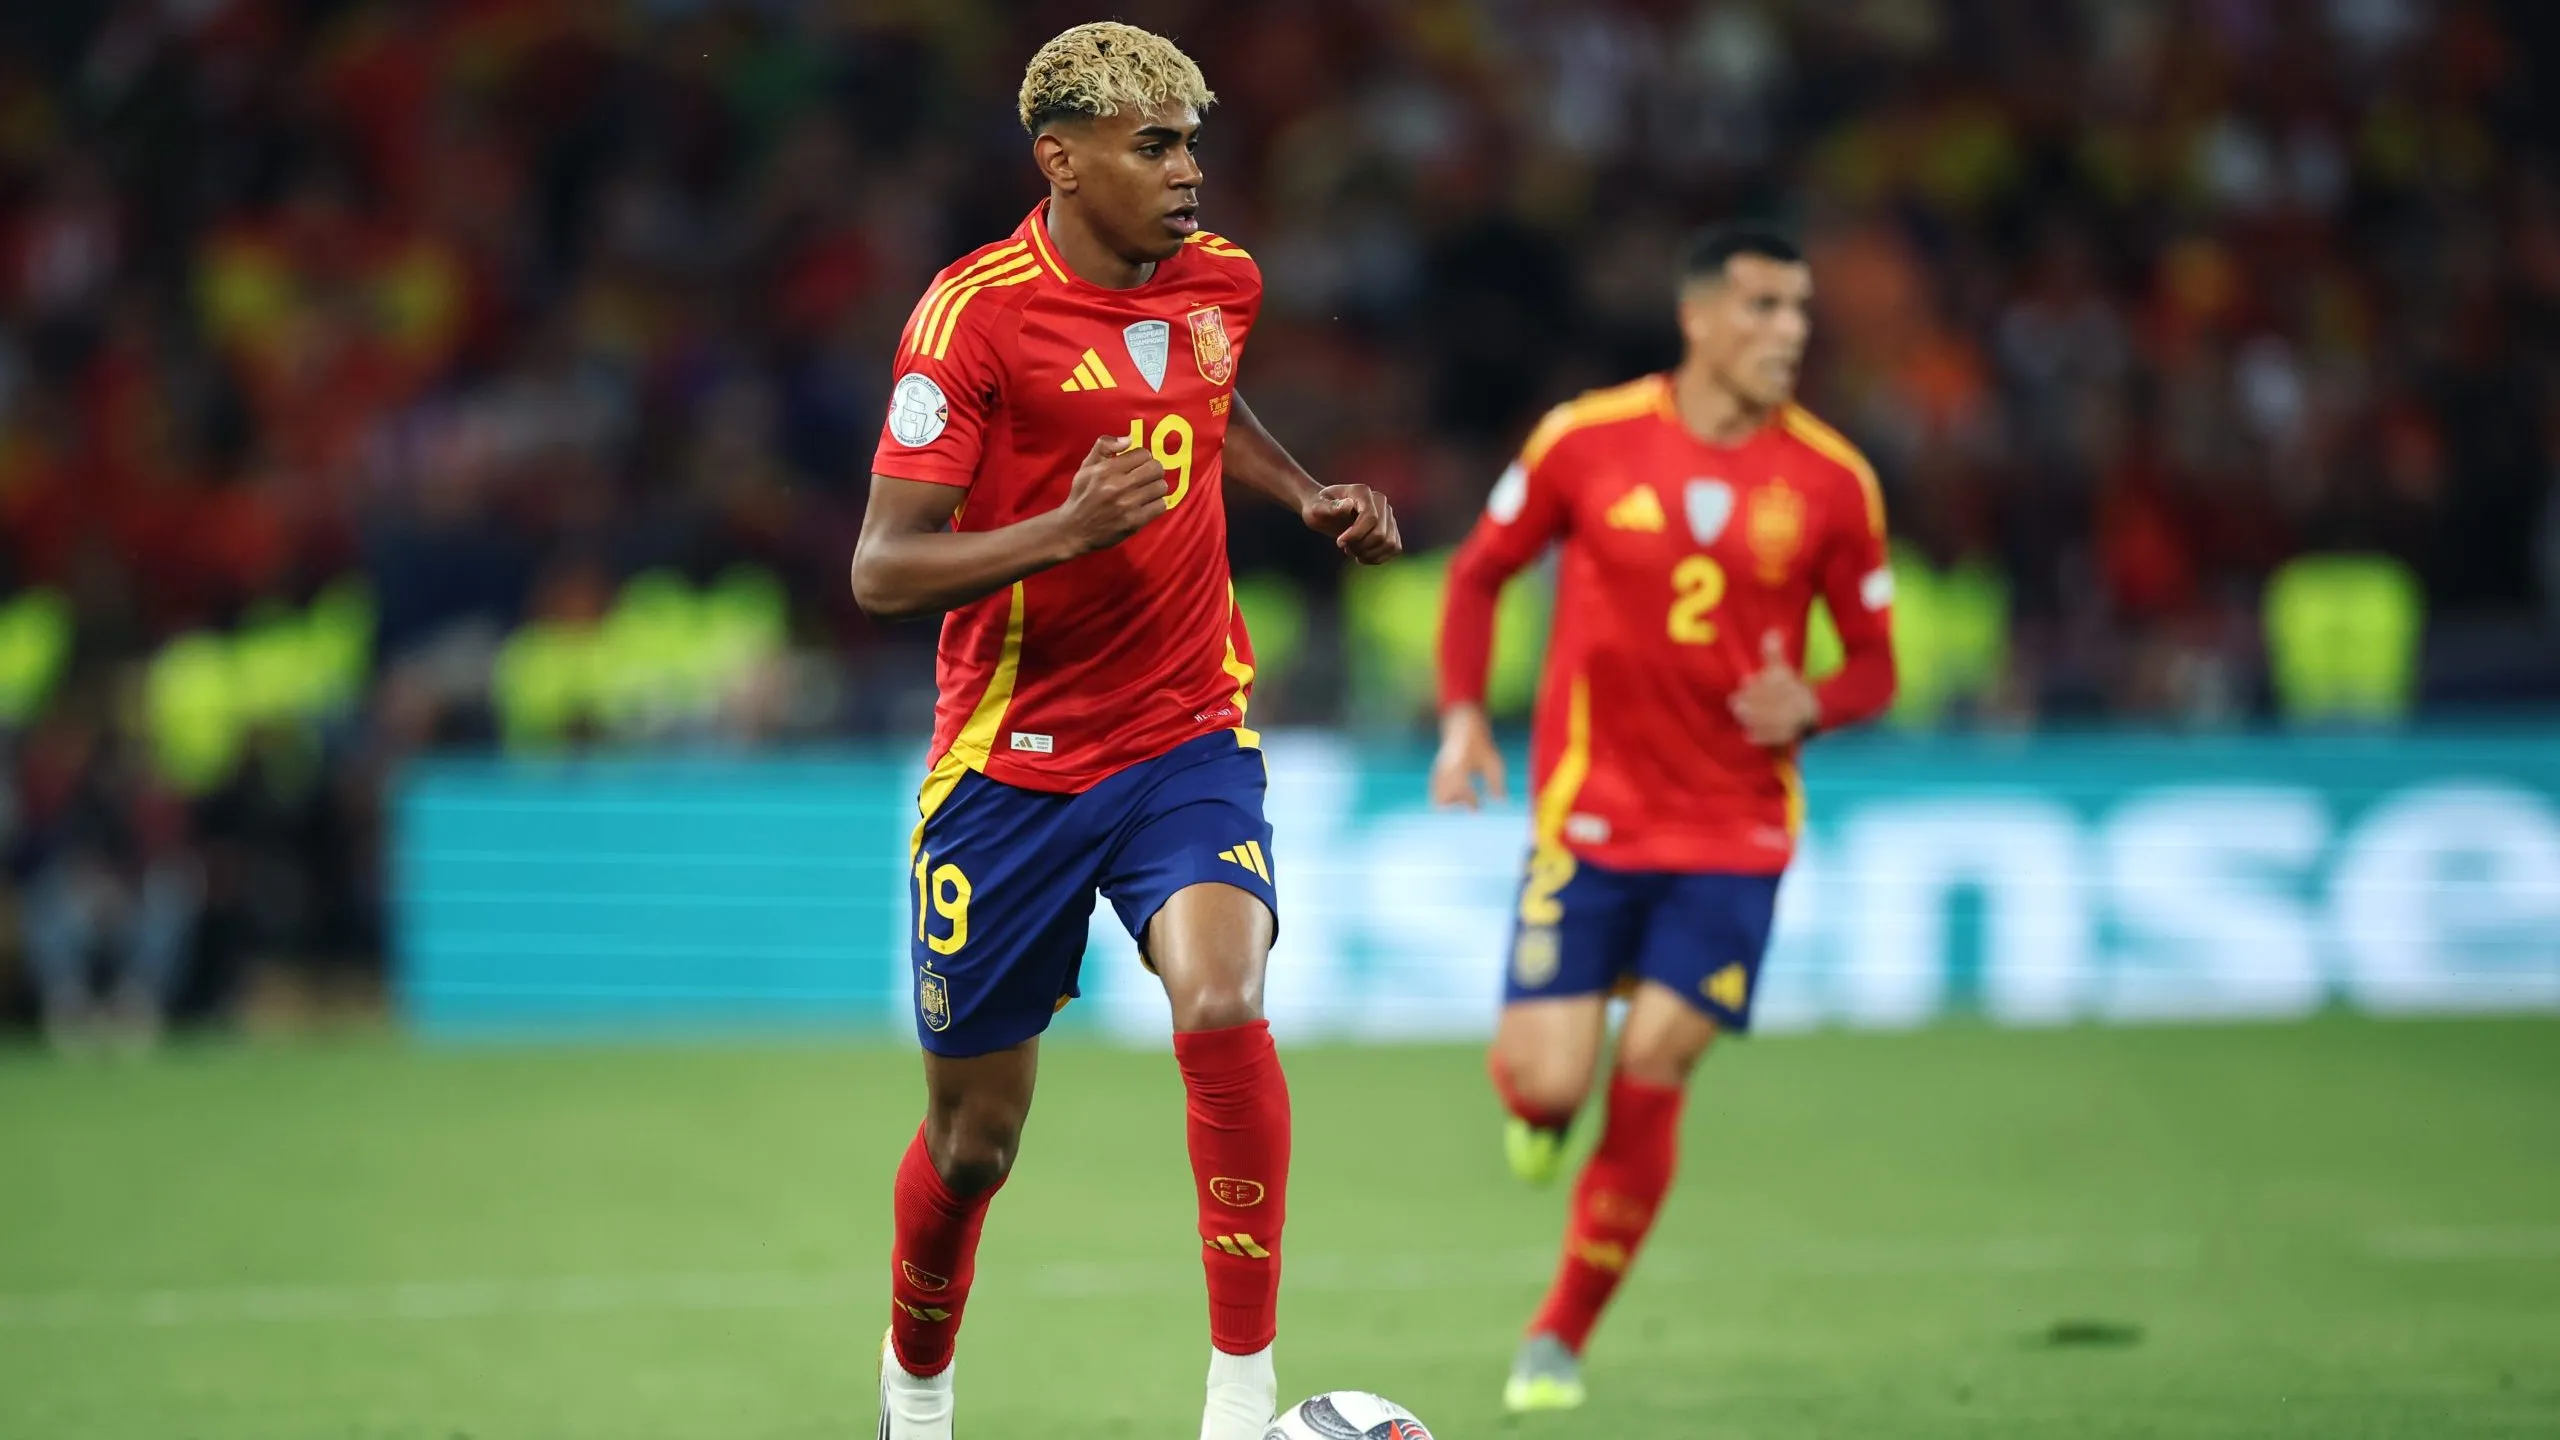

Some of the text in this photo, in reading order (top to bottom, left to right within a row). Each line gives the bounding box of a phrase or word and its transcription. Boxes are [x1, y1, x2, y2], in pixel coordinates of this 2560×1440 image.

[1129, 328, 1165, 340] EUROPEAN
[1130, 336, 1166, 348] CHAMPIONS
[924, 380, 941, 396] LEAGUE
[1667, 555, 1726, 645] 2
[915, 851, 972, 955] 19
[1520, 845, 1578, 927] 2
